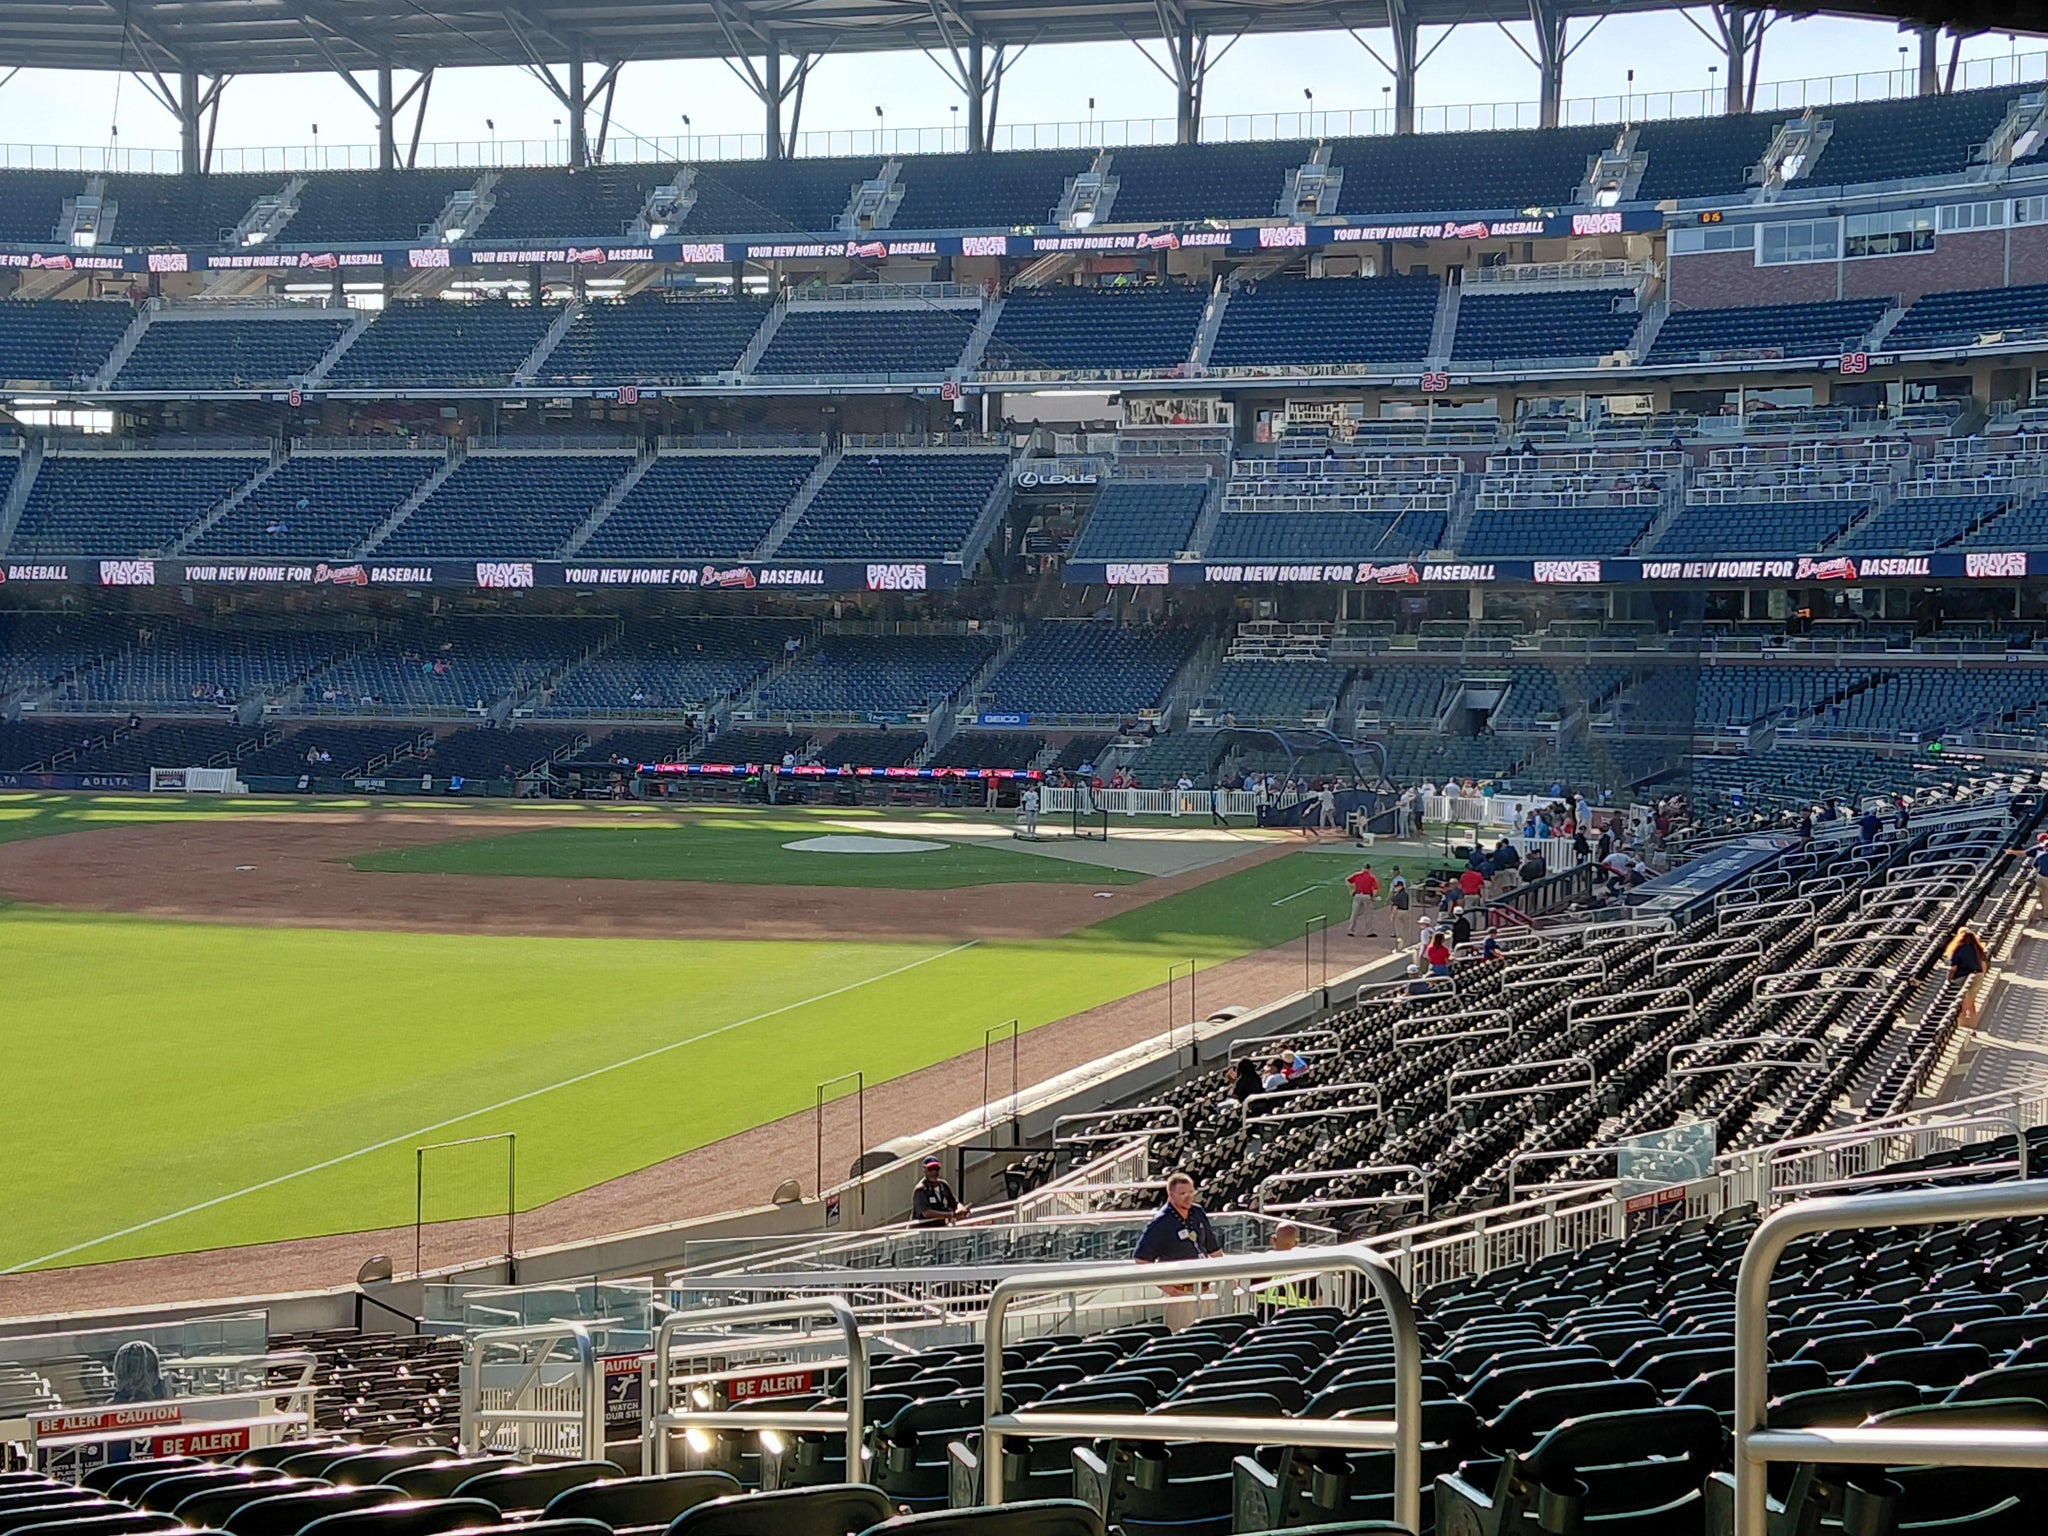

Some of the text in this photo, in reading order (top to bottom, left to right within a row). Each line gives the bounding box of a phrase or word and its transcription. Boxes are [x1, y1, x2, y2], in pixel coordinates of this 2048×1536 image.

[1572, 213, 1622, 225] BRAVES
[1259, 226, 1306, 237] BRAVES
[1333, 228, 1360, 240] YOUR
[1361, 227, 1386, 239] NEW
[1387, 226, 1419, 239] HOME
[1420, 225, 1442, 238] FOR
[1491, 221, 1544, 235] BASEBALL
[1573, 223, 1622, 235] VISION
[962, 237, 1006, 247] BRAVES
[1033, 238, 1058, 250] YOUR
[1060, 238, 1084, 250] NEW
[1084, 237, 1113, 249] HOME
[1115, 236, 1135, 248] FOR
[1182, 233, 1232, 246] BASEBALL
[1260, 235, 1306, 247] VISION
[408, 249, 449, 258] BRAVES
[682, 244, 724, 253] BRAVES
[747, 247, 772, 258] YOUR
[773, 246, 796, 257] NEW
[796, 245, 824, 256] HOME
[825, 244, 844, 256] FOR
[889, 242, 936, 255] BASEBALL
[963, 246, 1006, 256] VISION
[9, 255, 29, 266] FOR
[74, 256, 123, 269] BASEBALL
[148, 254, 187, 263] BRAVES
[208, 256, 231, 267] YOUR
[231, 256, 254, 267] NEW
[253, 256, 279, 266] HOME
[280, 255, 298, 266] FOR
[339, 254, 383, 265] BASEBALL
[409, 257, 450, 268] VISION
[472, 252, 496, 263] YOUR
[497, 251, 518, 262] NEW
[518, 251, 545, 262] HOME
[546, 251, 565, 262] FOR
[608, 249, 653, 260] BASEBALL
[682, 252, 724, 263] VISION
[148, 262, 188, 272] VISION
[1840, 352, 1867, 374] 29
[1421, 371, 1448, 391] 25
[618, 386, 638, 404] 10
[941, 381, 960, 400] 21
[289, 388, 301, 407] 6
[1040, 474, 1097, 484] LEXUS
[1966, 553, 2026, 564] BRAVES
[8, 566, 68, 580] BASEBALL
[100, 561, 154, 572] BRAVES
[476, 563, 533, 575] BRAVES
[866, 565, 926, 577] BRAVES
[1204, 566, 1242, 581] YOUR
[1244, 566, 1279, 581] NEW
[1278, 566, 1322, 581] HOME
[1323, 565, 1353, 581] FOR
[1422, 565, 1495, 580] BASEBALL
[1534, 562, 1600, 572] BRAVES
[1642, 563, 1681, 578] YOUR
[1682, 562, 1716, 578] NEW
[1717, 562, 1763, 578] HOME
[1763, 561, 1793, 577] FOR
[1860, 558, 1930, 576] BASEBALL
[100, 571, 155, 584] VISION
[185, 567, 217, 581] YOUR
[218, 567, 248, 581] NEW
[249, 567, 286, 581] HOME
[287, 567, 311, 581] FOR
[371, 567, 433, 582] BASEBALL
[477, 574, 533, 588] VISION
[565, 568, 599, 583] YOUR
[600, 569, 632, 583] NEW
[632, 569, 670, 583] HOME
[671, 569, 698, 584] FOR
[759, 569, 825, 584] BASEBALL
[867, 575, 926, 589] VISION
[985, 714, 1020, 723] GEICO
[93, 777, 130, 786] DELTA
[605, 1358, 642, 1373] AUTIO
[737, 1375, 804, 1396] BE ALERT
[609, 1403, 639, 1412] WATCH
[116, 1406, 178, 1424] CAUTION
[605, 1410, 642, 1421] OUR STE
[41, 1415, 103, 1432] BE ALERT
[162, 1432, 243, 1454] BE ALERT
